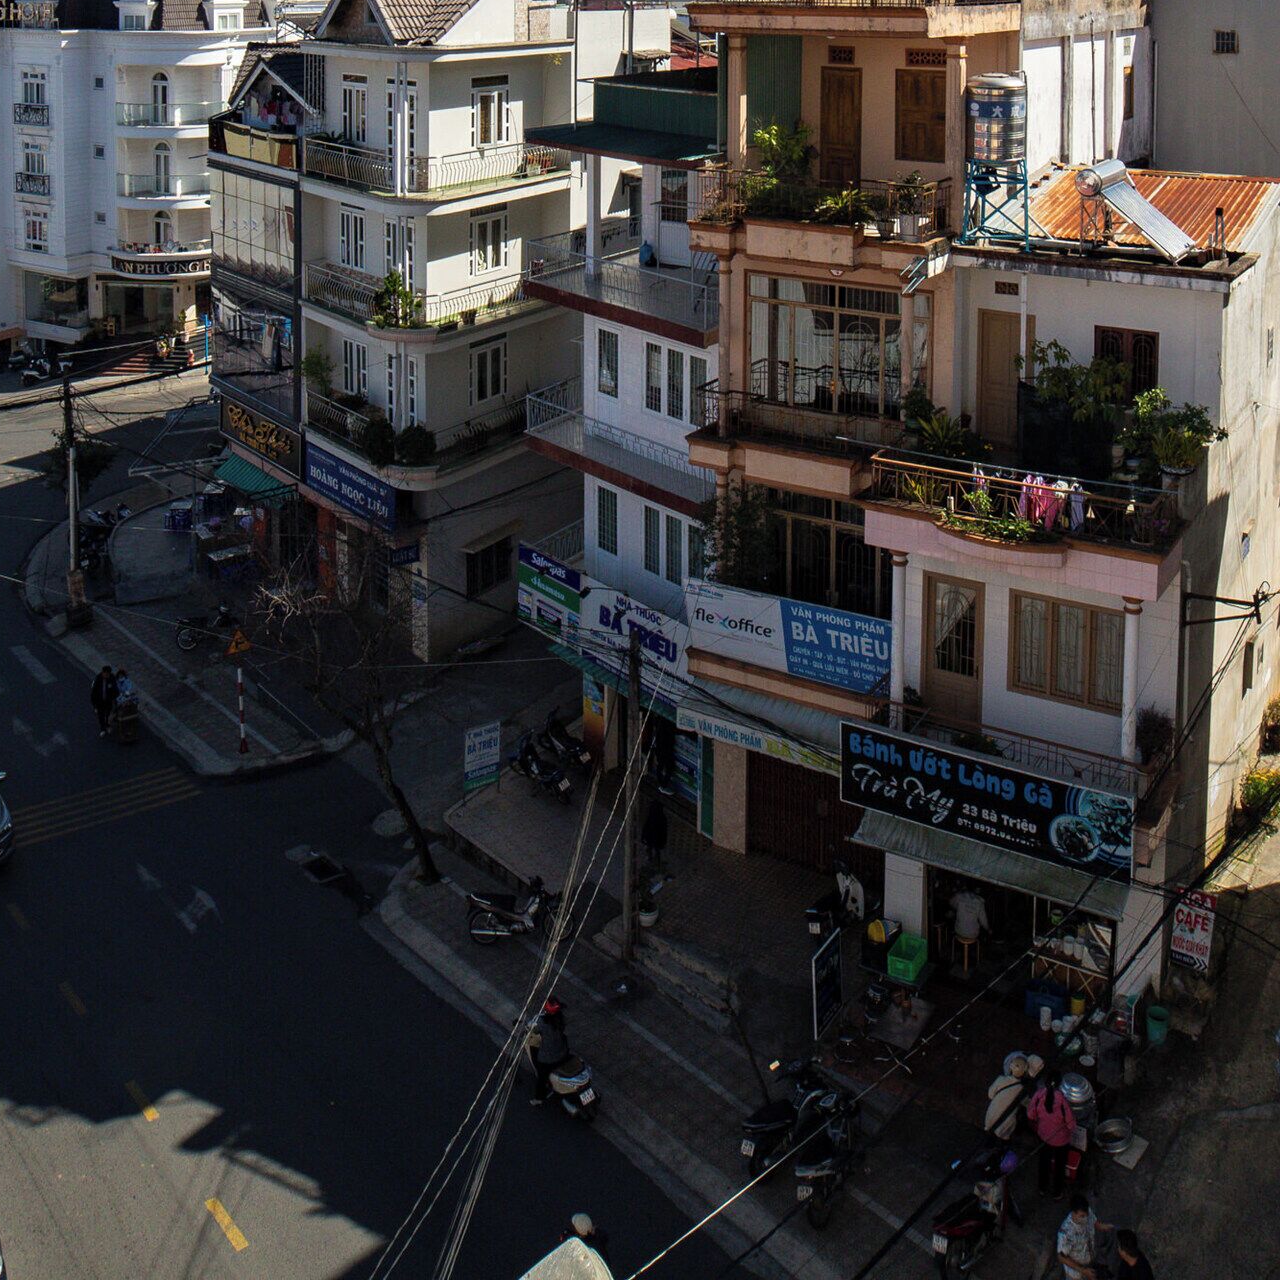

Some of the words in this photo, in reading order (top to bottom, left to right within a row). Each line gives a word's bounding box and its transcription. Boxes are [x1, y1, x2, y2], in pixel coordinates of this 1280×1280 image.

[136, 260, 200, 275] PHƯƠNG
[310, 464, 339, 491] HOÀNG
[341, 481, 366, 506] NGỌC
[816, 608, 851, 628] PHÒNG
[791, 618, 820, 646] BÀ
[826, 628, 889, 663] TRIỆU
[713, 723, 739, 742] PHÒNG
[848, 730, 903, 768] Bánh
[907, 747, 953, 781] Ướt
[957, 762, 1016, 802] Lòng
[1023, 780, 1054, 810] Gà
[961, 802, 978, 818] 23
[981, 806, 1001, 825] Bà
[1000, 810, 1039, 836] Triệu
